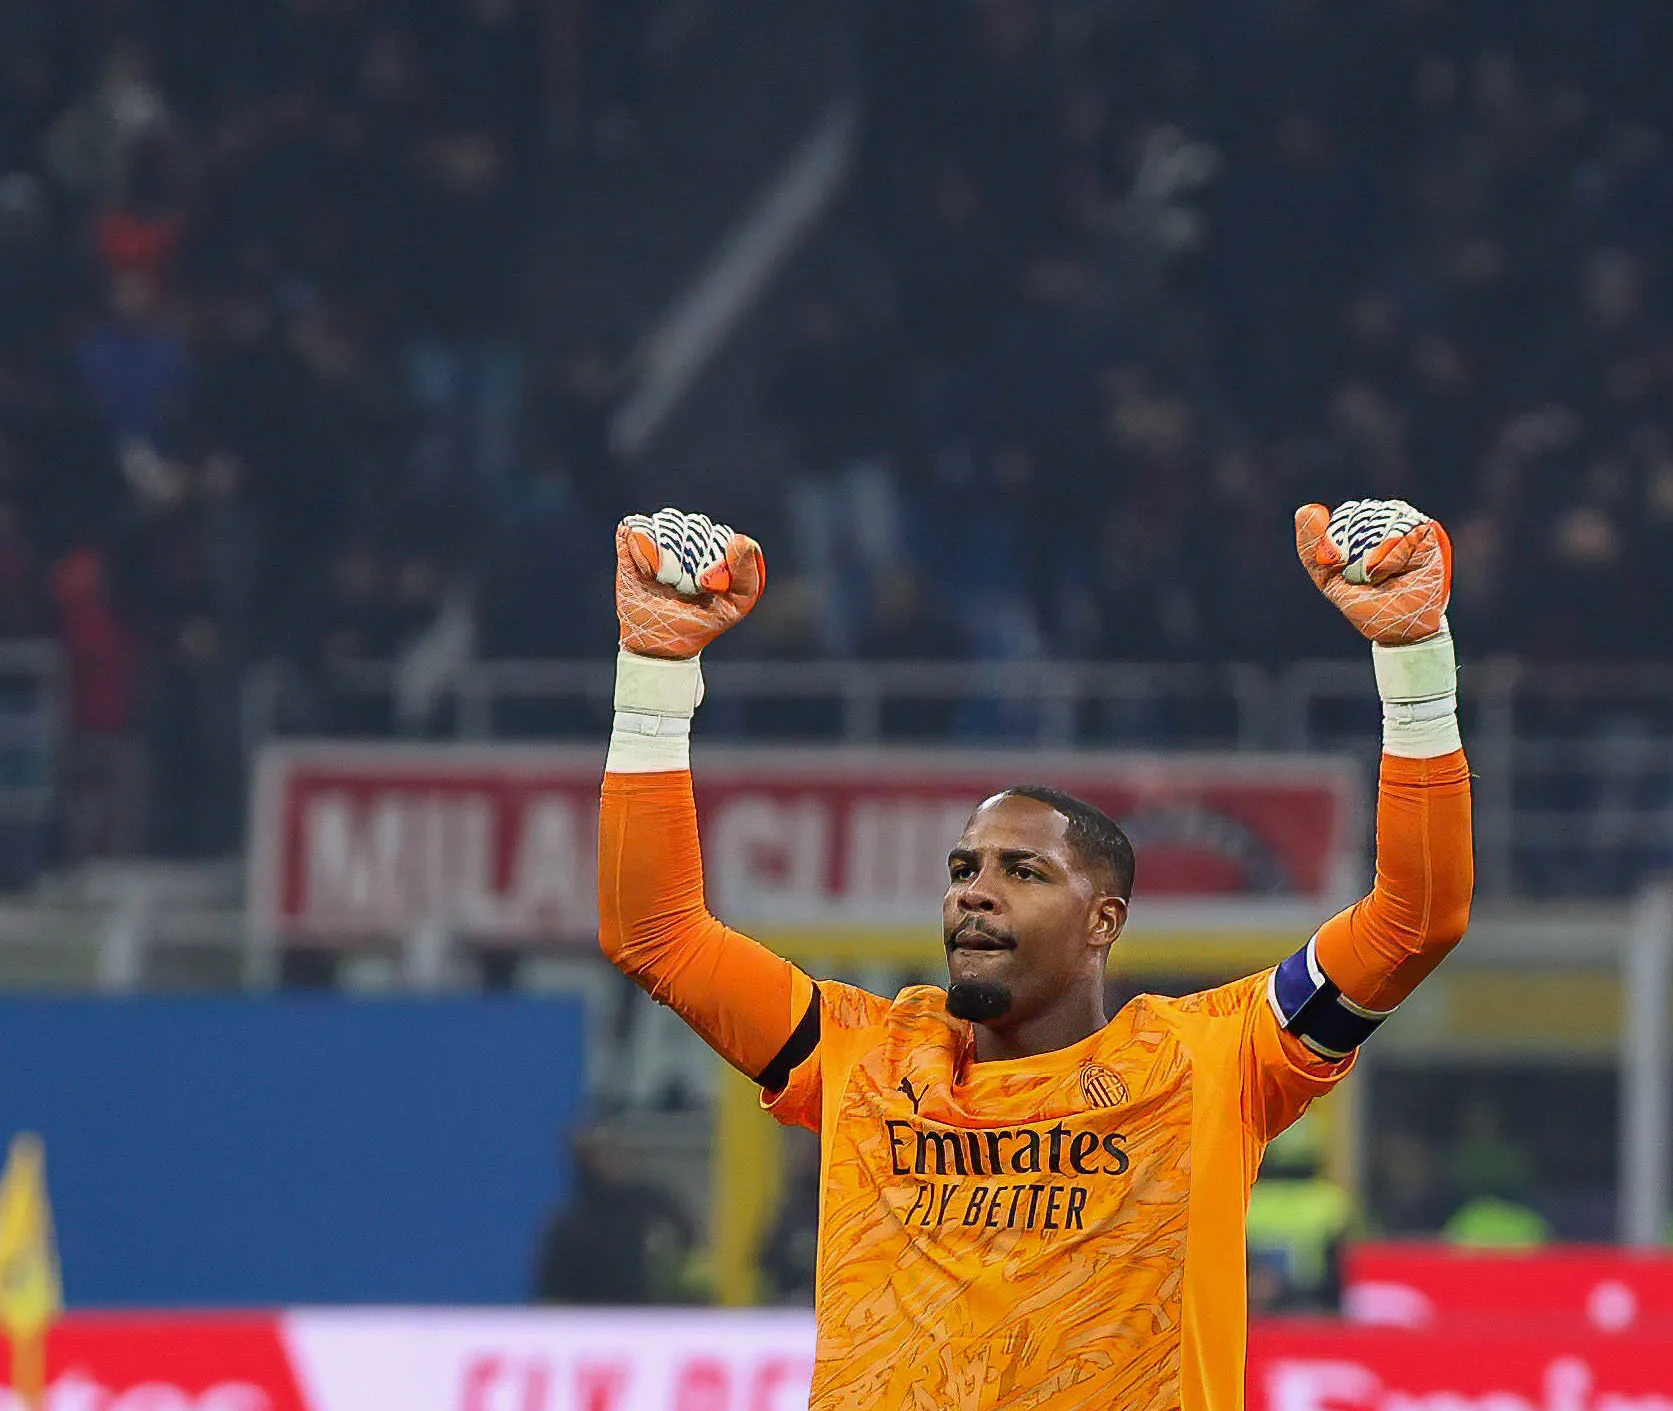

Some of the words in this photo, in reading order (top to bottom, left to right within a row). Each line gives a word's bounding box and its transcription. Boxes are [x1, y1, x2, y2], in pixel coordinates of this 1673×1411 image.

[311, 793, 598, 932] MILA
[885, 1118, 1131, 1180] Emirates
[903, 1182, 960, 1227] FLY
[961, 1185, 1088, 1231] BETTER
